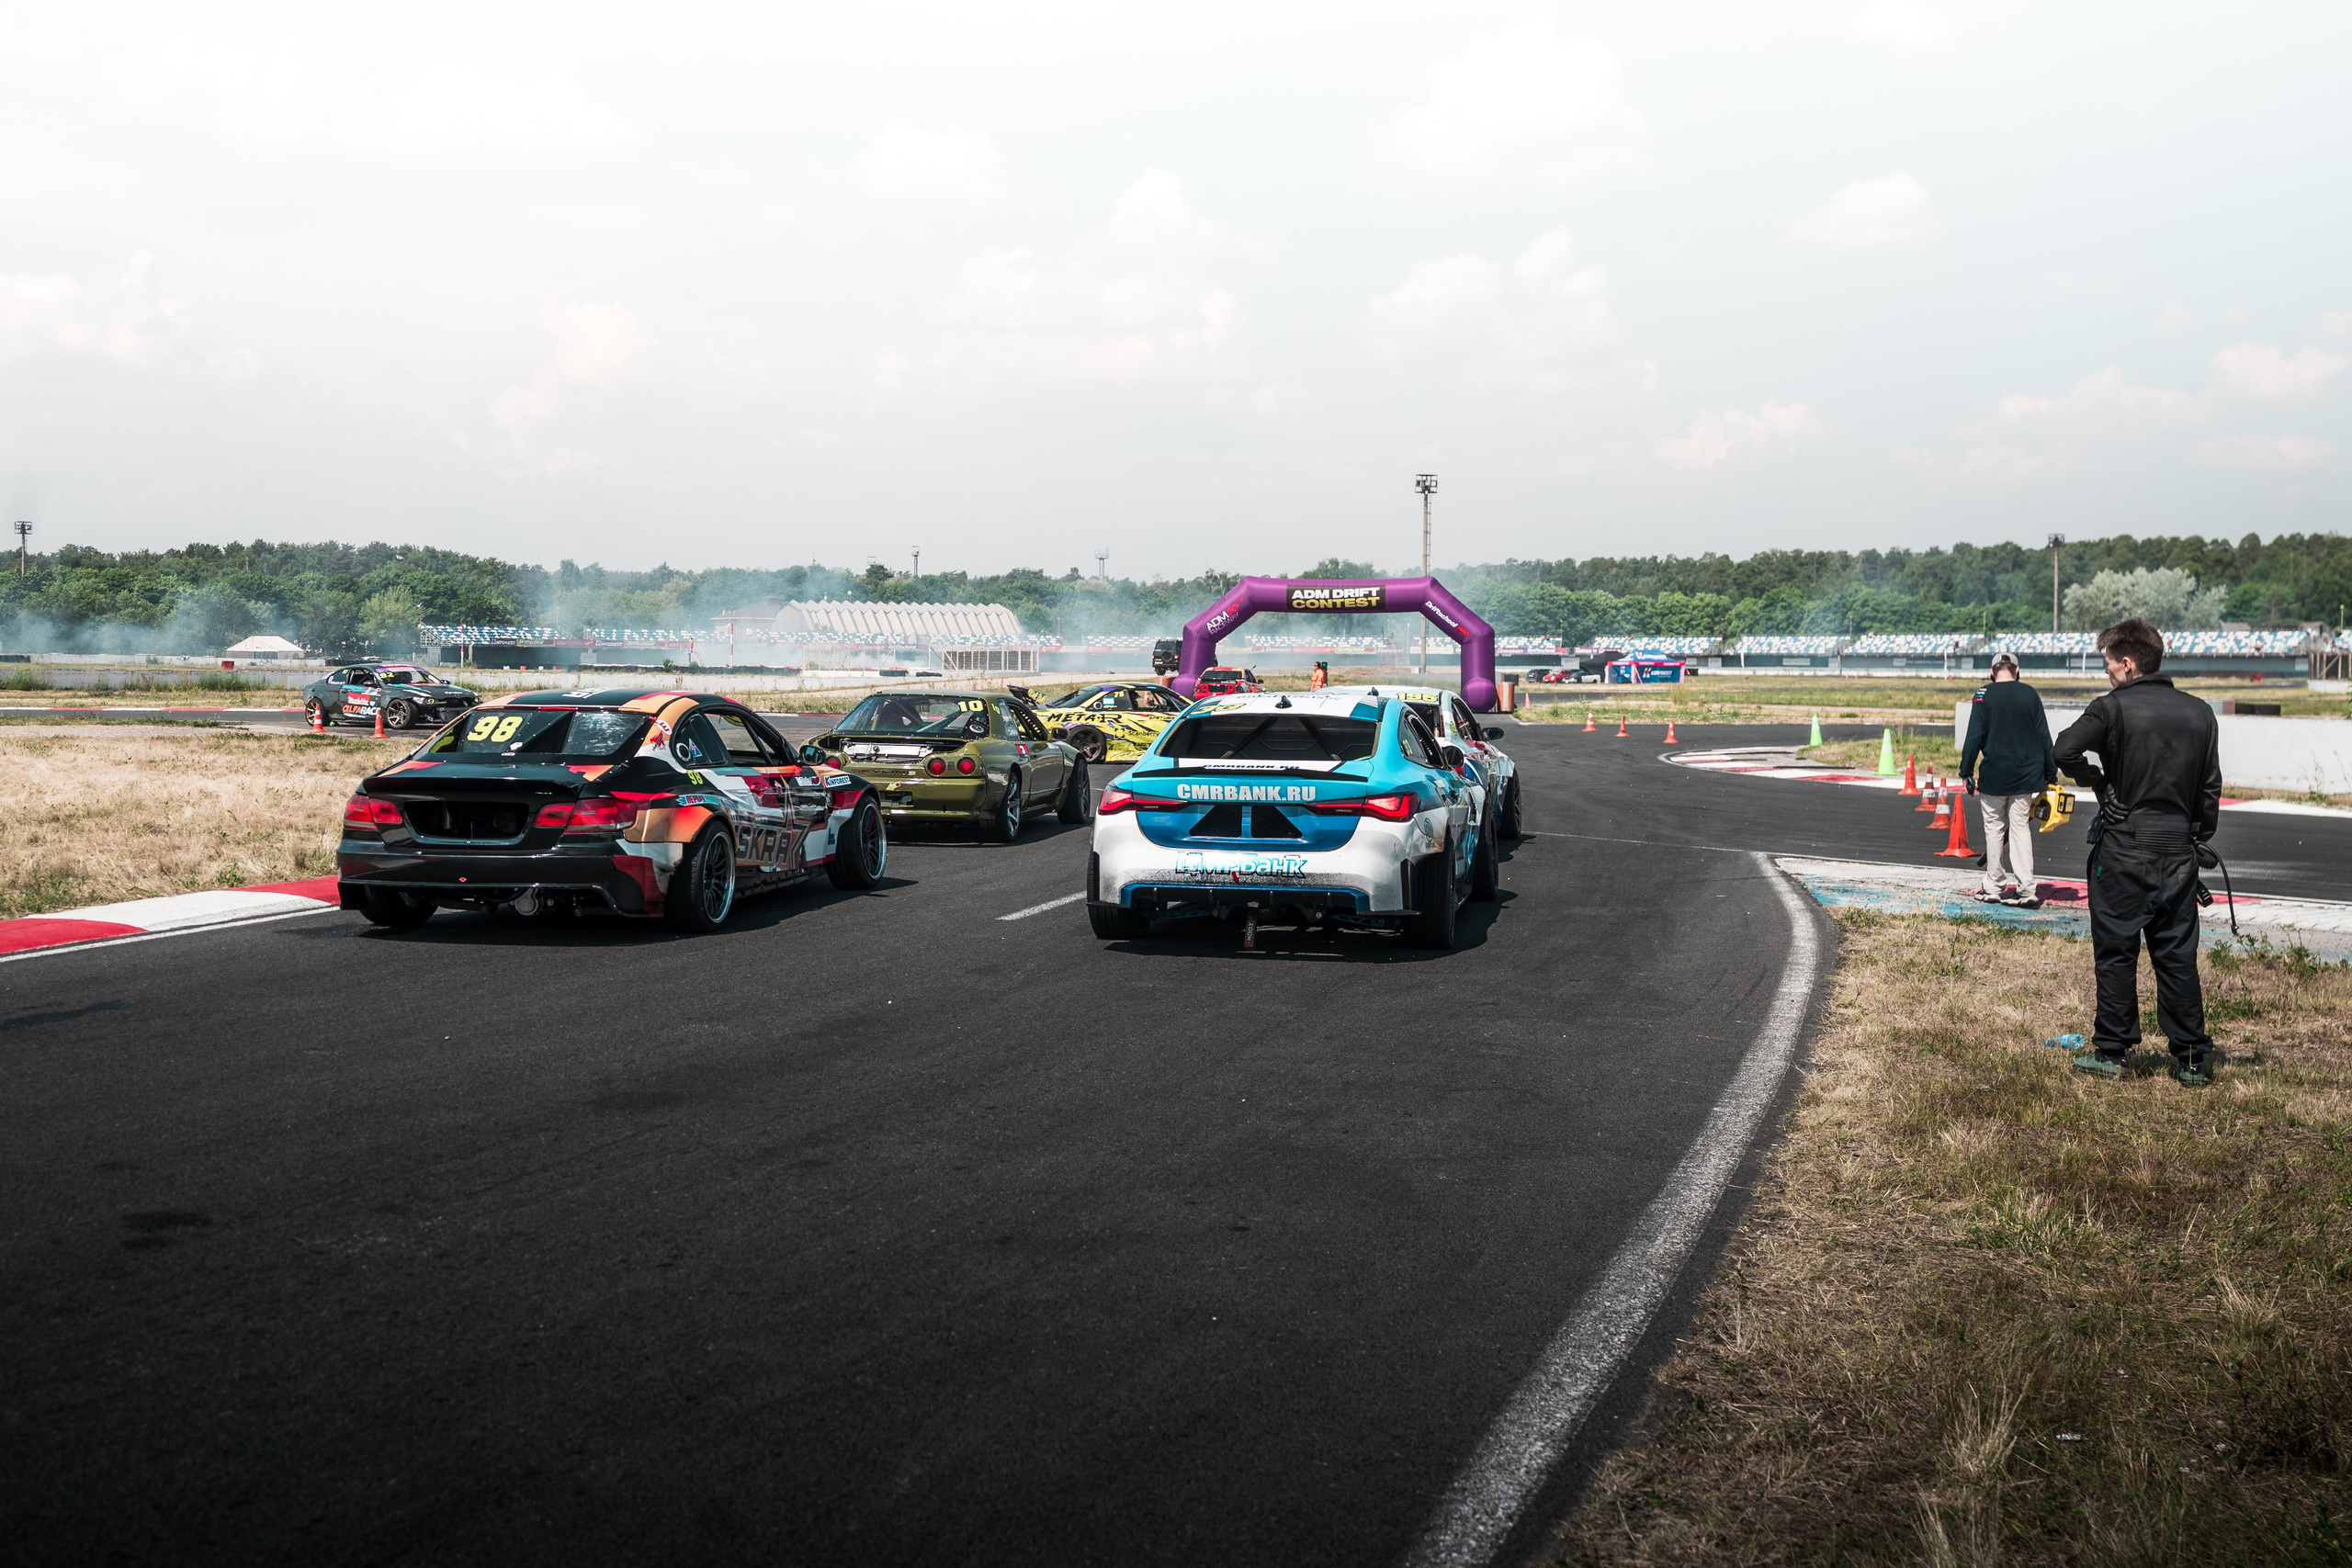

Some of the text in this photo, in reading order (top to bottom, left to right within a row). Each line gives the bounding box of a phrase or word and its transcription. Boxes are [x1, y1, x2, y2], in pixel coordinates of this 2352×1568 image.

[1292, 587, 1380, 599] ADM DRIFT
[1292, 596, 1380, 608] CONTEST
[1206, 611, 1229, 631] ADM
[1425, 600, 1459, 627] Driftschool
[1209, 612, 1238, 635] RACEWAY
[957, 700, 983, 712] 10
[467, 716, 523, 742] 98
[687, 770, 703, 785] 98
[1177, 784, 1316, 802] CMRBANK.RU
